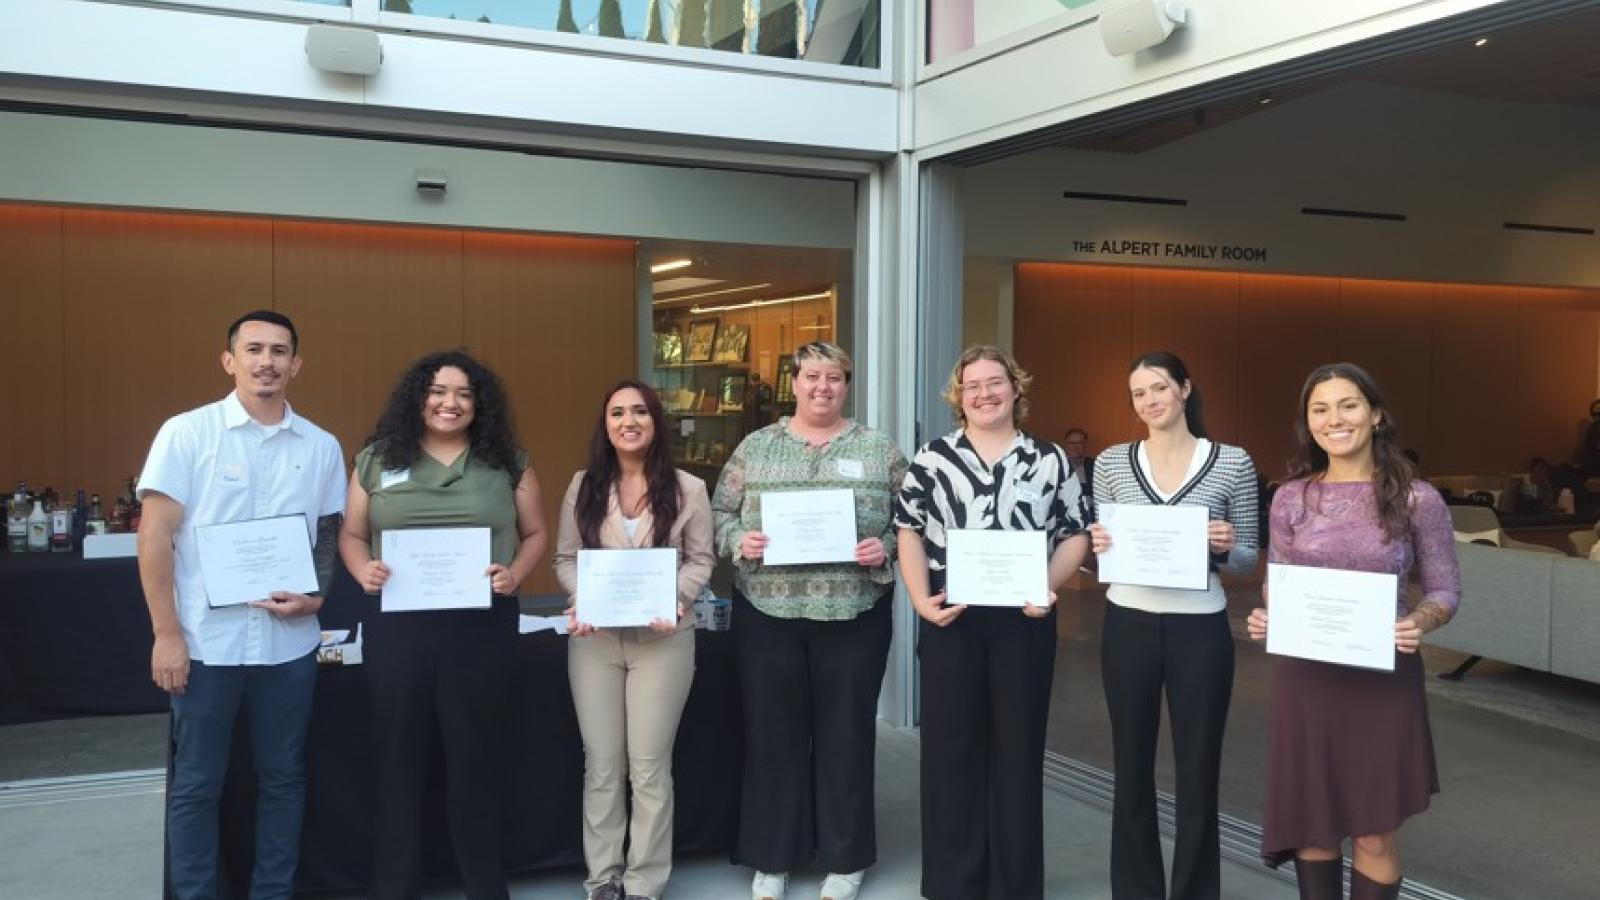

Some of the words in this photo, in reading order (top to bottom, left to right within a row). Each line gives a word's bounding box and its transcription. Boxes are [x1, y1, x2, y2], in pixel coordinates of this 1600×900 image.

[1073, 240, 1096, 253] THE
[1100, 240, 1160, 257] ALPERT
[1165, 243, 1218, 259] FAMILY
[1221, 246, 1267, 261] ROOM
